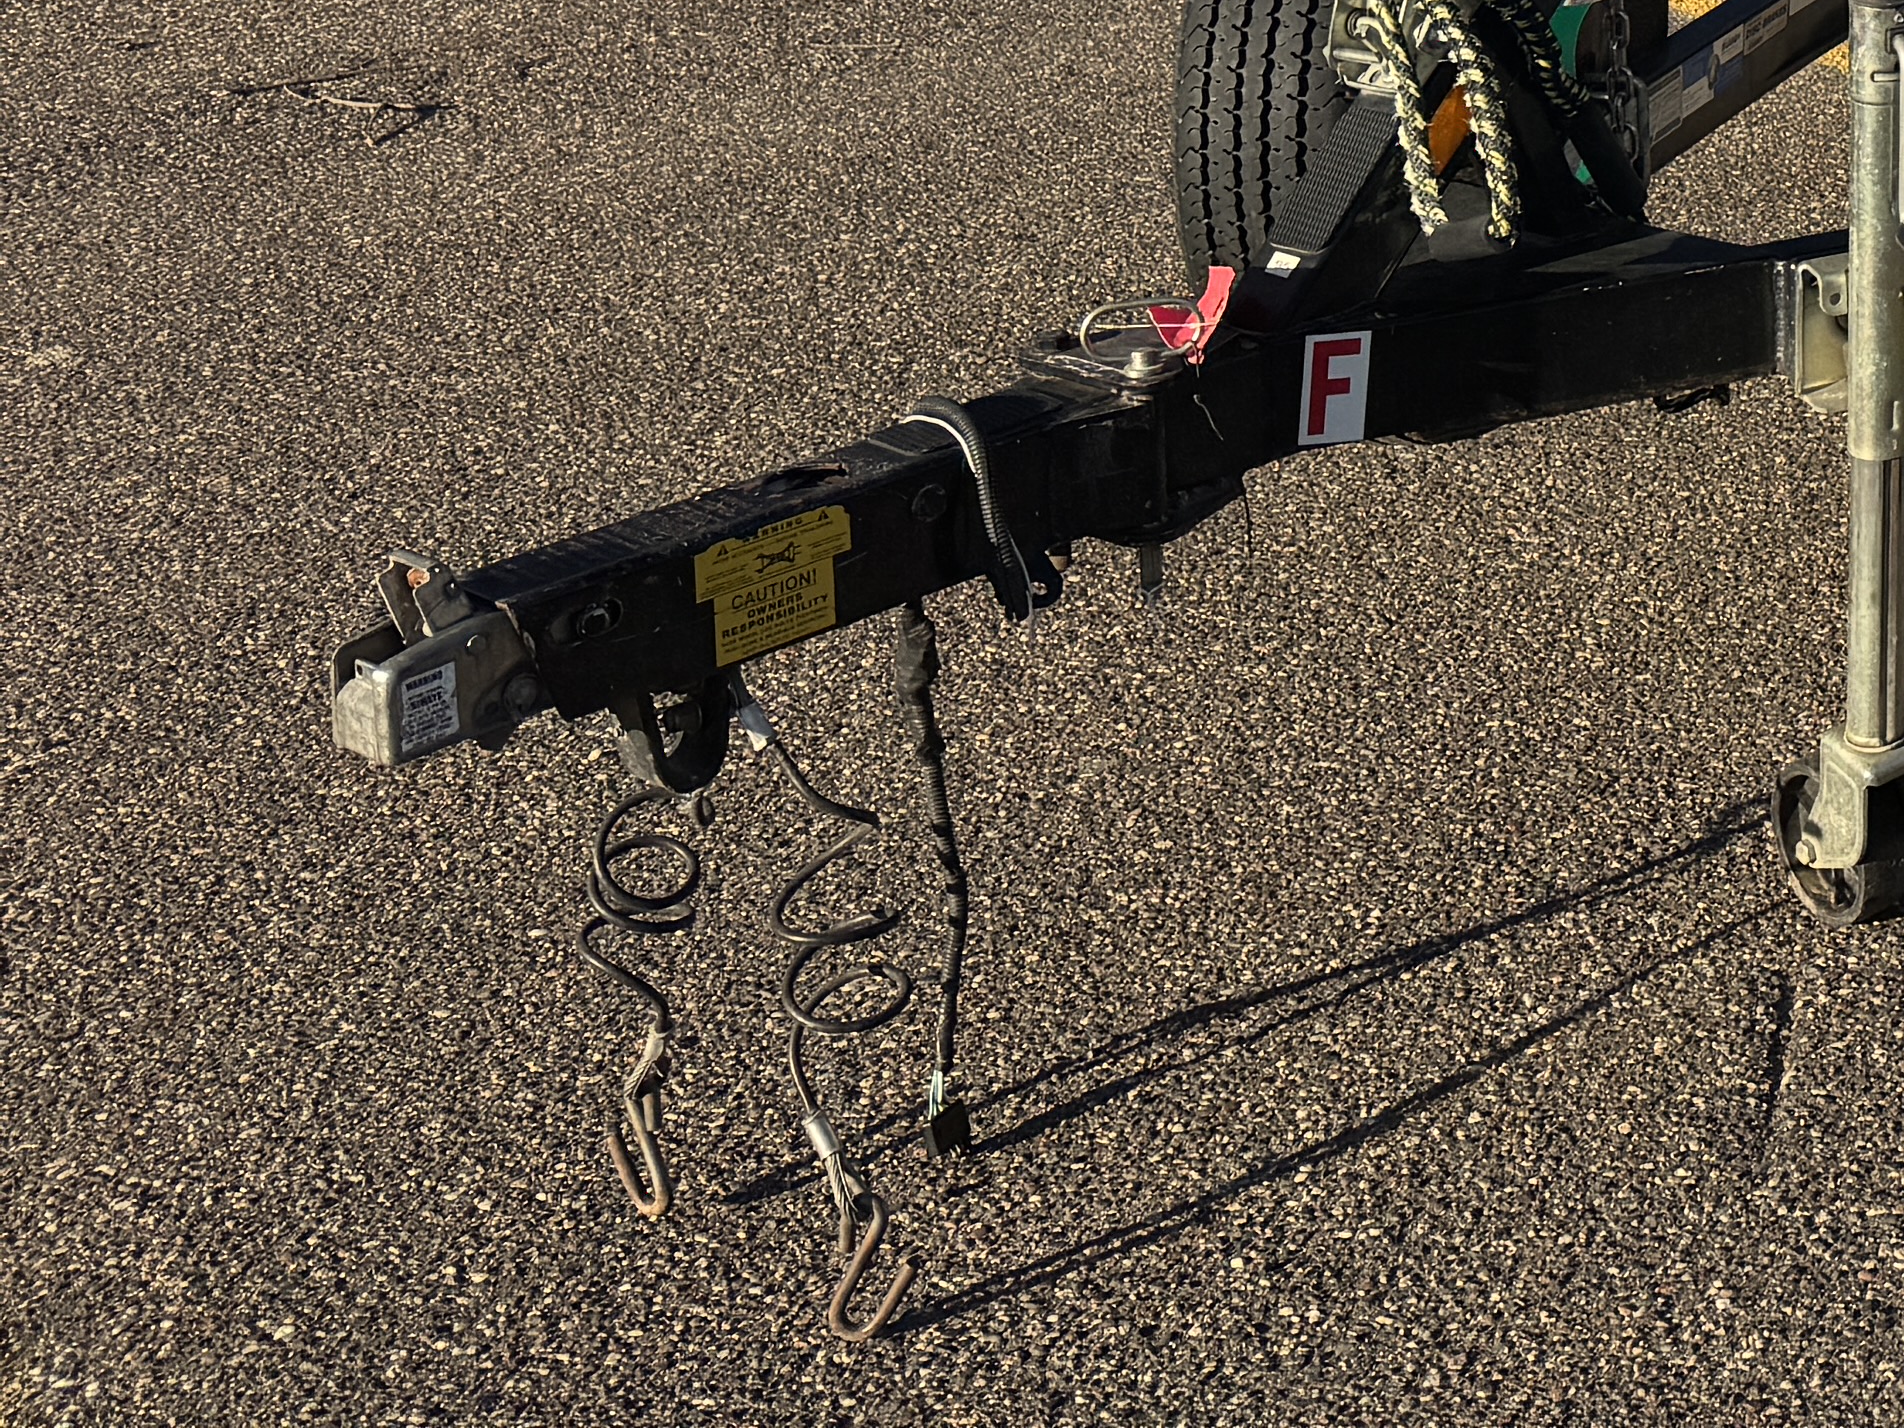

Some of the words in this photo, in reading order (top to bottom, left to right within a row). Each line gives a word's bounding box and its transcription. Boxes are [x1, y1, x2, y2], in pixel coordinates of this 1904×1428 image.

[1306, 337, 1362, 437] F
[731, 567, 818, 611] CAUTION!
[721, 594, 829, 640] RESPONSIBILITY
